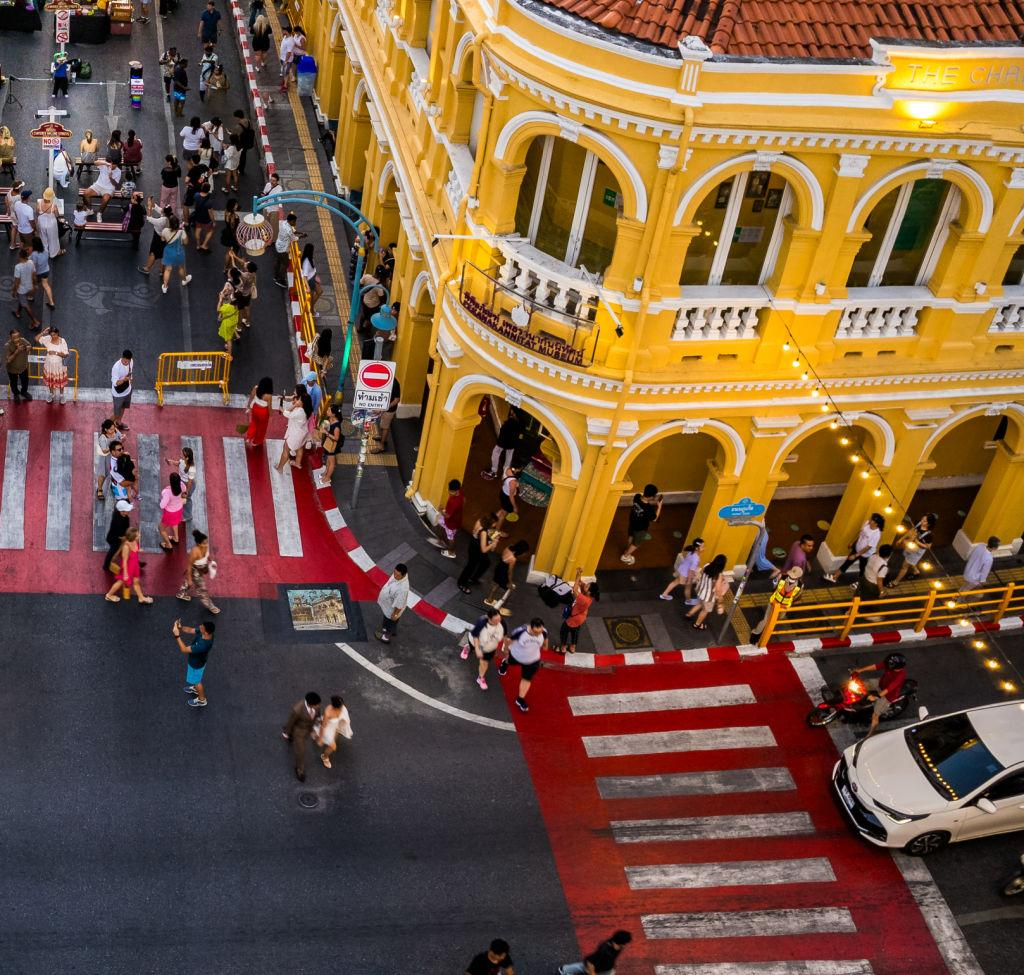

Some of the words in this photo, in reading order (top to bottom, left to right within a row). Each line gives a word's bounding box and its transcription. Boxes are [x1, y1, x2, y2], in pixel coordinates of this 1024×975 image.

[907, 64, 960, 84] THE
[969, 64, 1024, 85] CHA
[538, 344, 583, 365] MUSEUM
[357, 391, 388, 402] ห้ามเข้า
